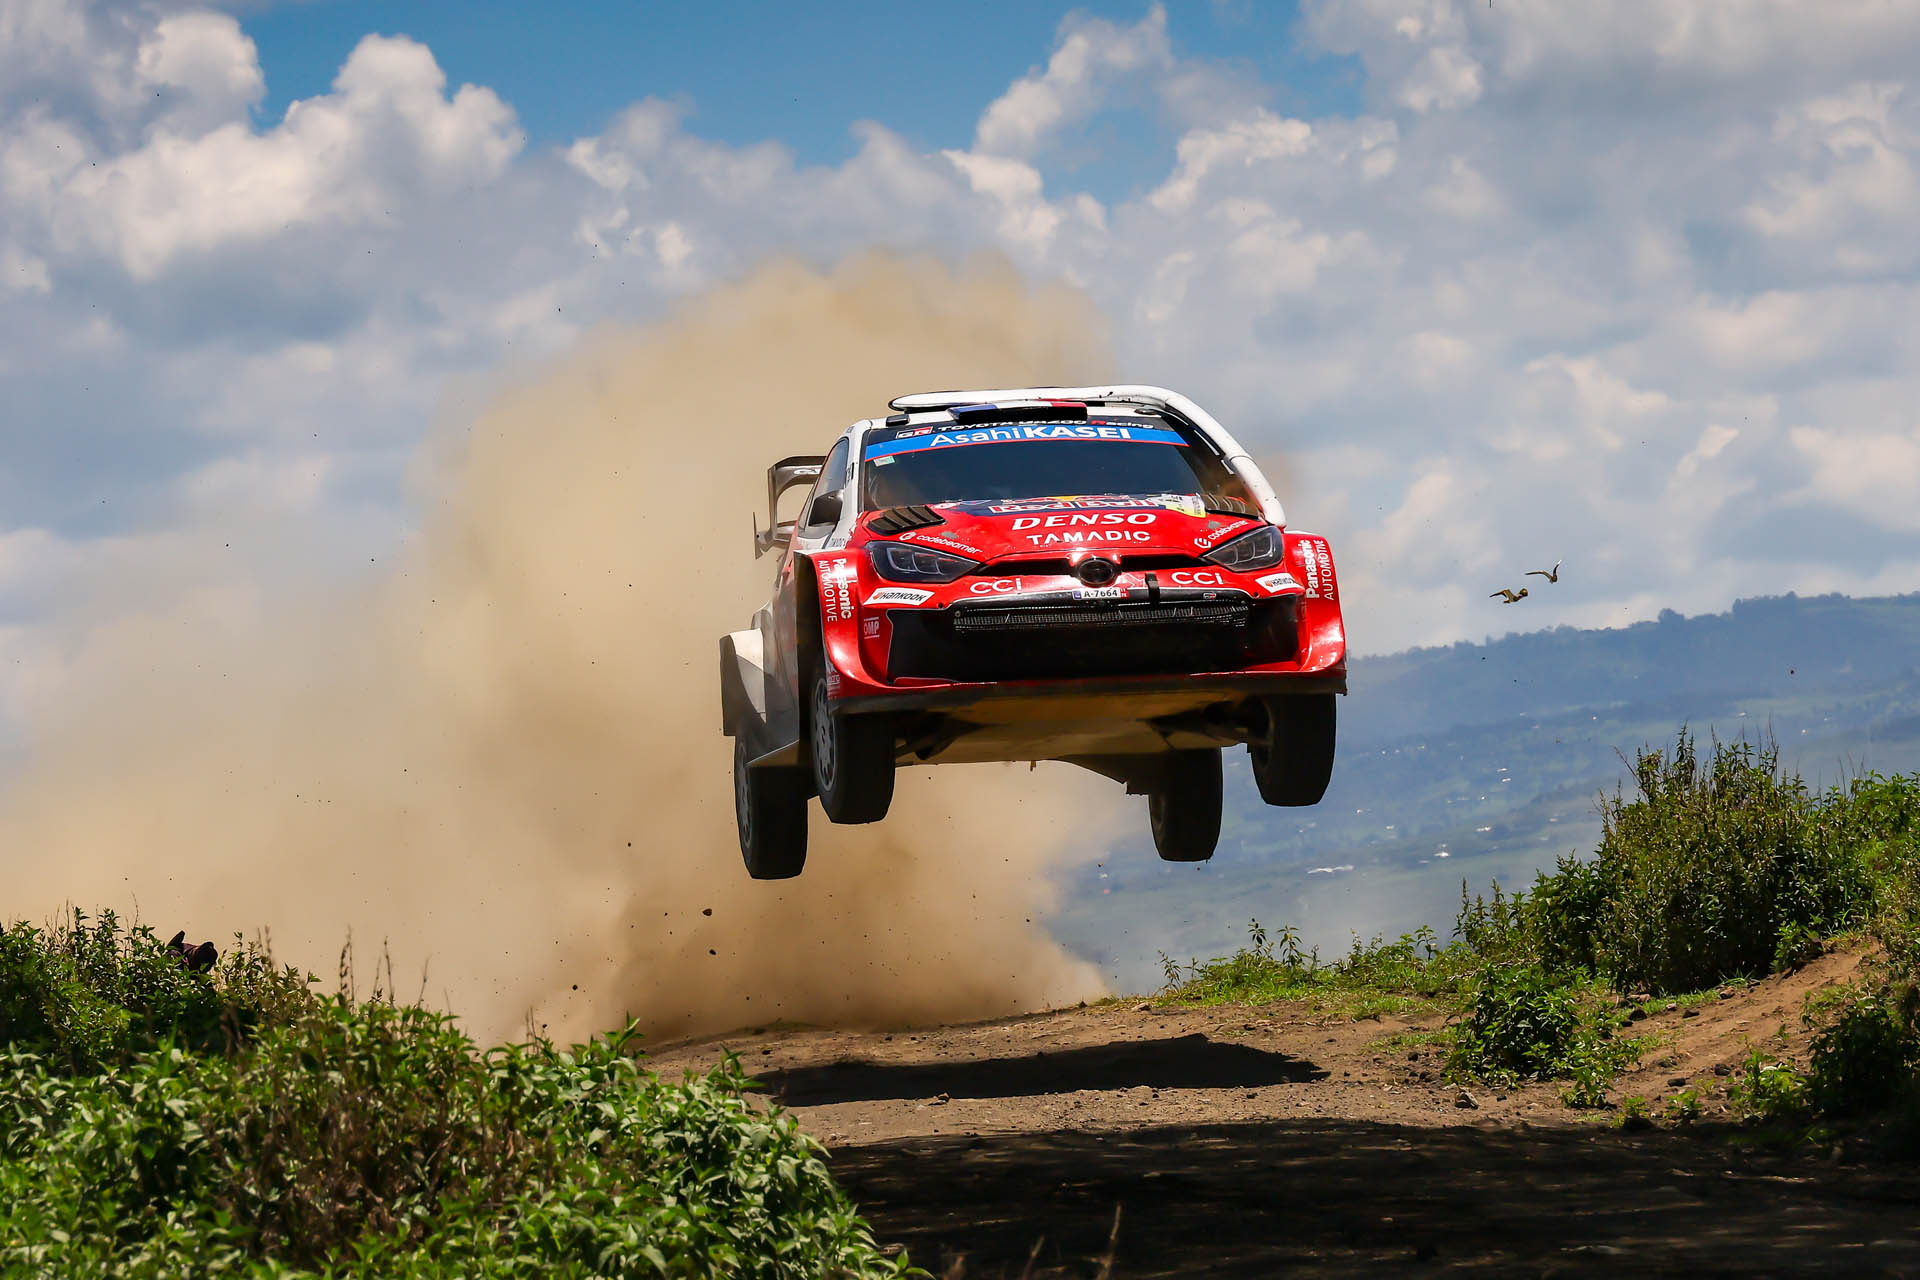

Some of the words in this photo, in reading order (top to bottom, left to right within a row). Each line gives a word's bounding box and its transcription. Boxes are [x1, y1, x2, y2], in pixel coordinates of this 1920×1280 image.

[988, 501, 1075, 513] Red
[1012, 513, 1156, 530] DENSO
[916, 534, 983, 554] codebeamer
[1026, 531, 1151, 545] TAMADIC
[1298, 539, 1321, 599] Panasonic
